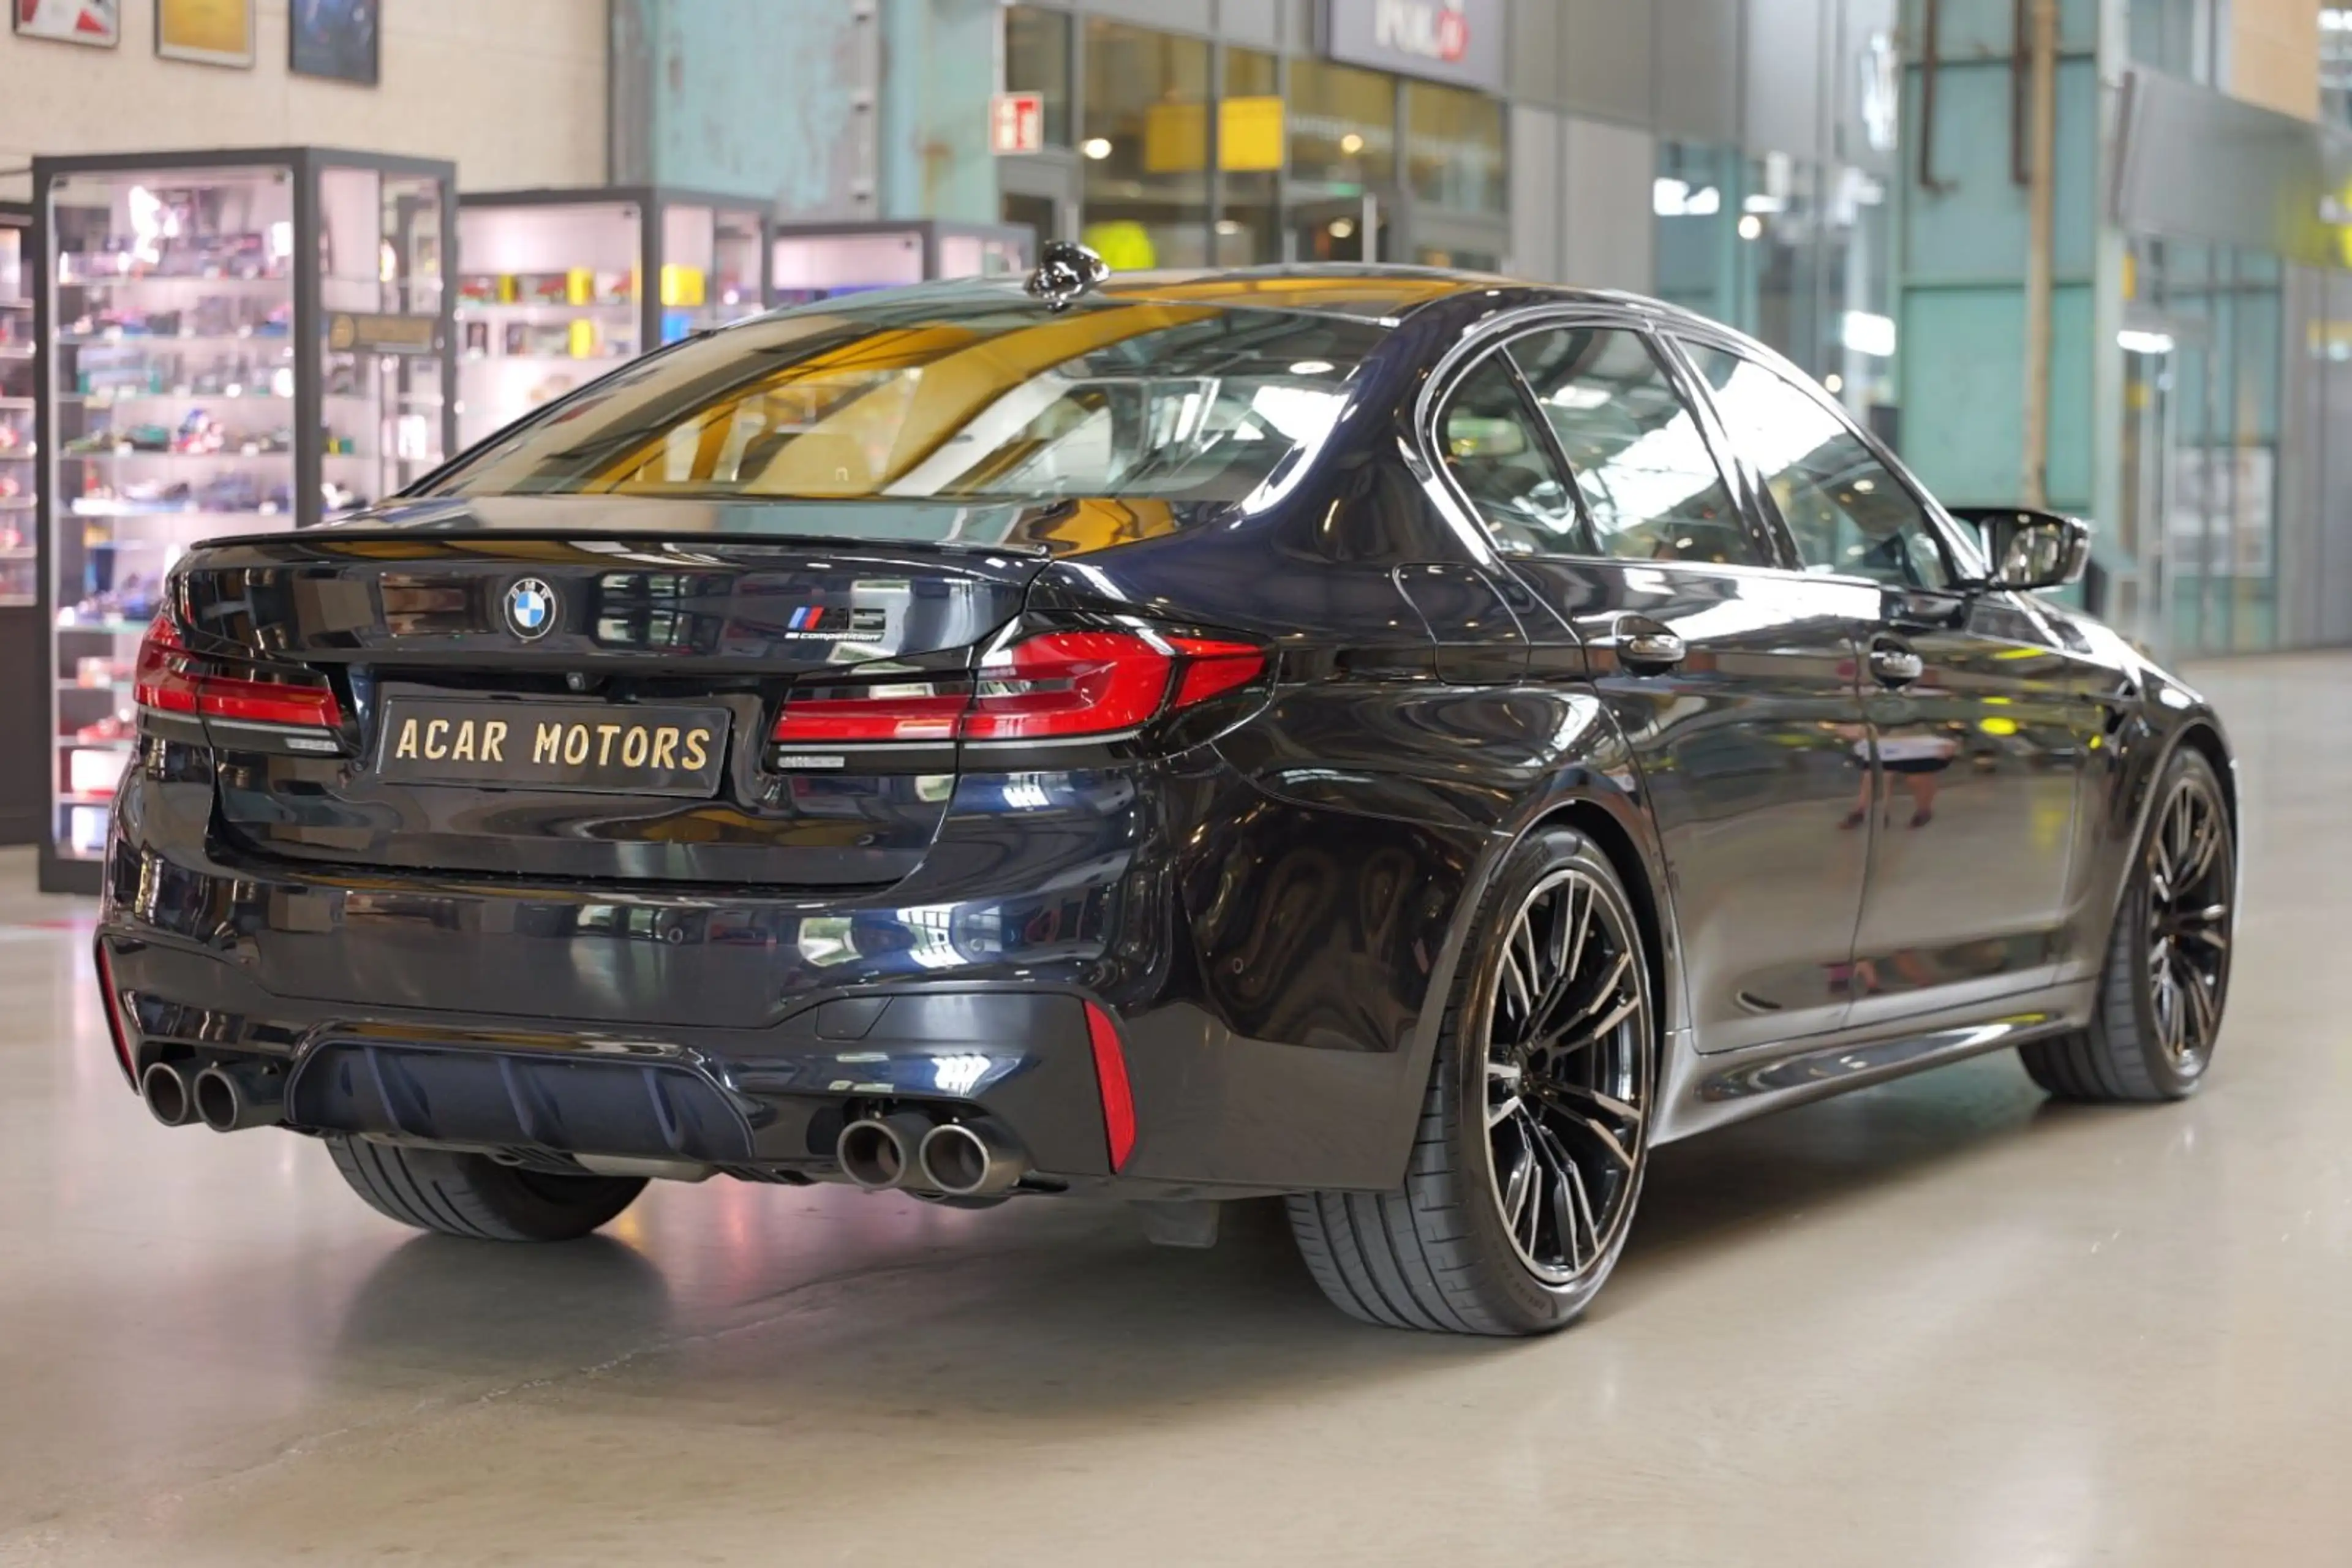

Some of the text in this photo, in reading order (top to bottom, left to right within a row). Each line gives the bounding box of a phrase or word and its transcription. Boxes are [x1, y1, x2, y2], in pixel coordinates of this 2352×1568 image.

[510, 581, 551, 600] BMW
[395, 718, 710, 770] ACAR MOTORS
